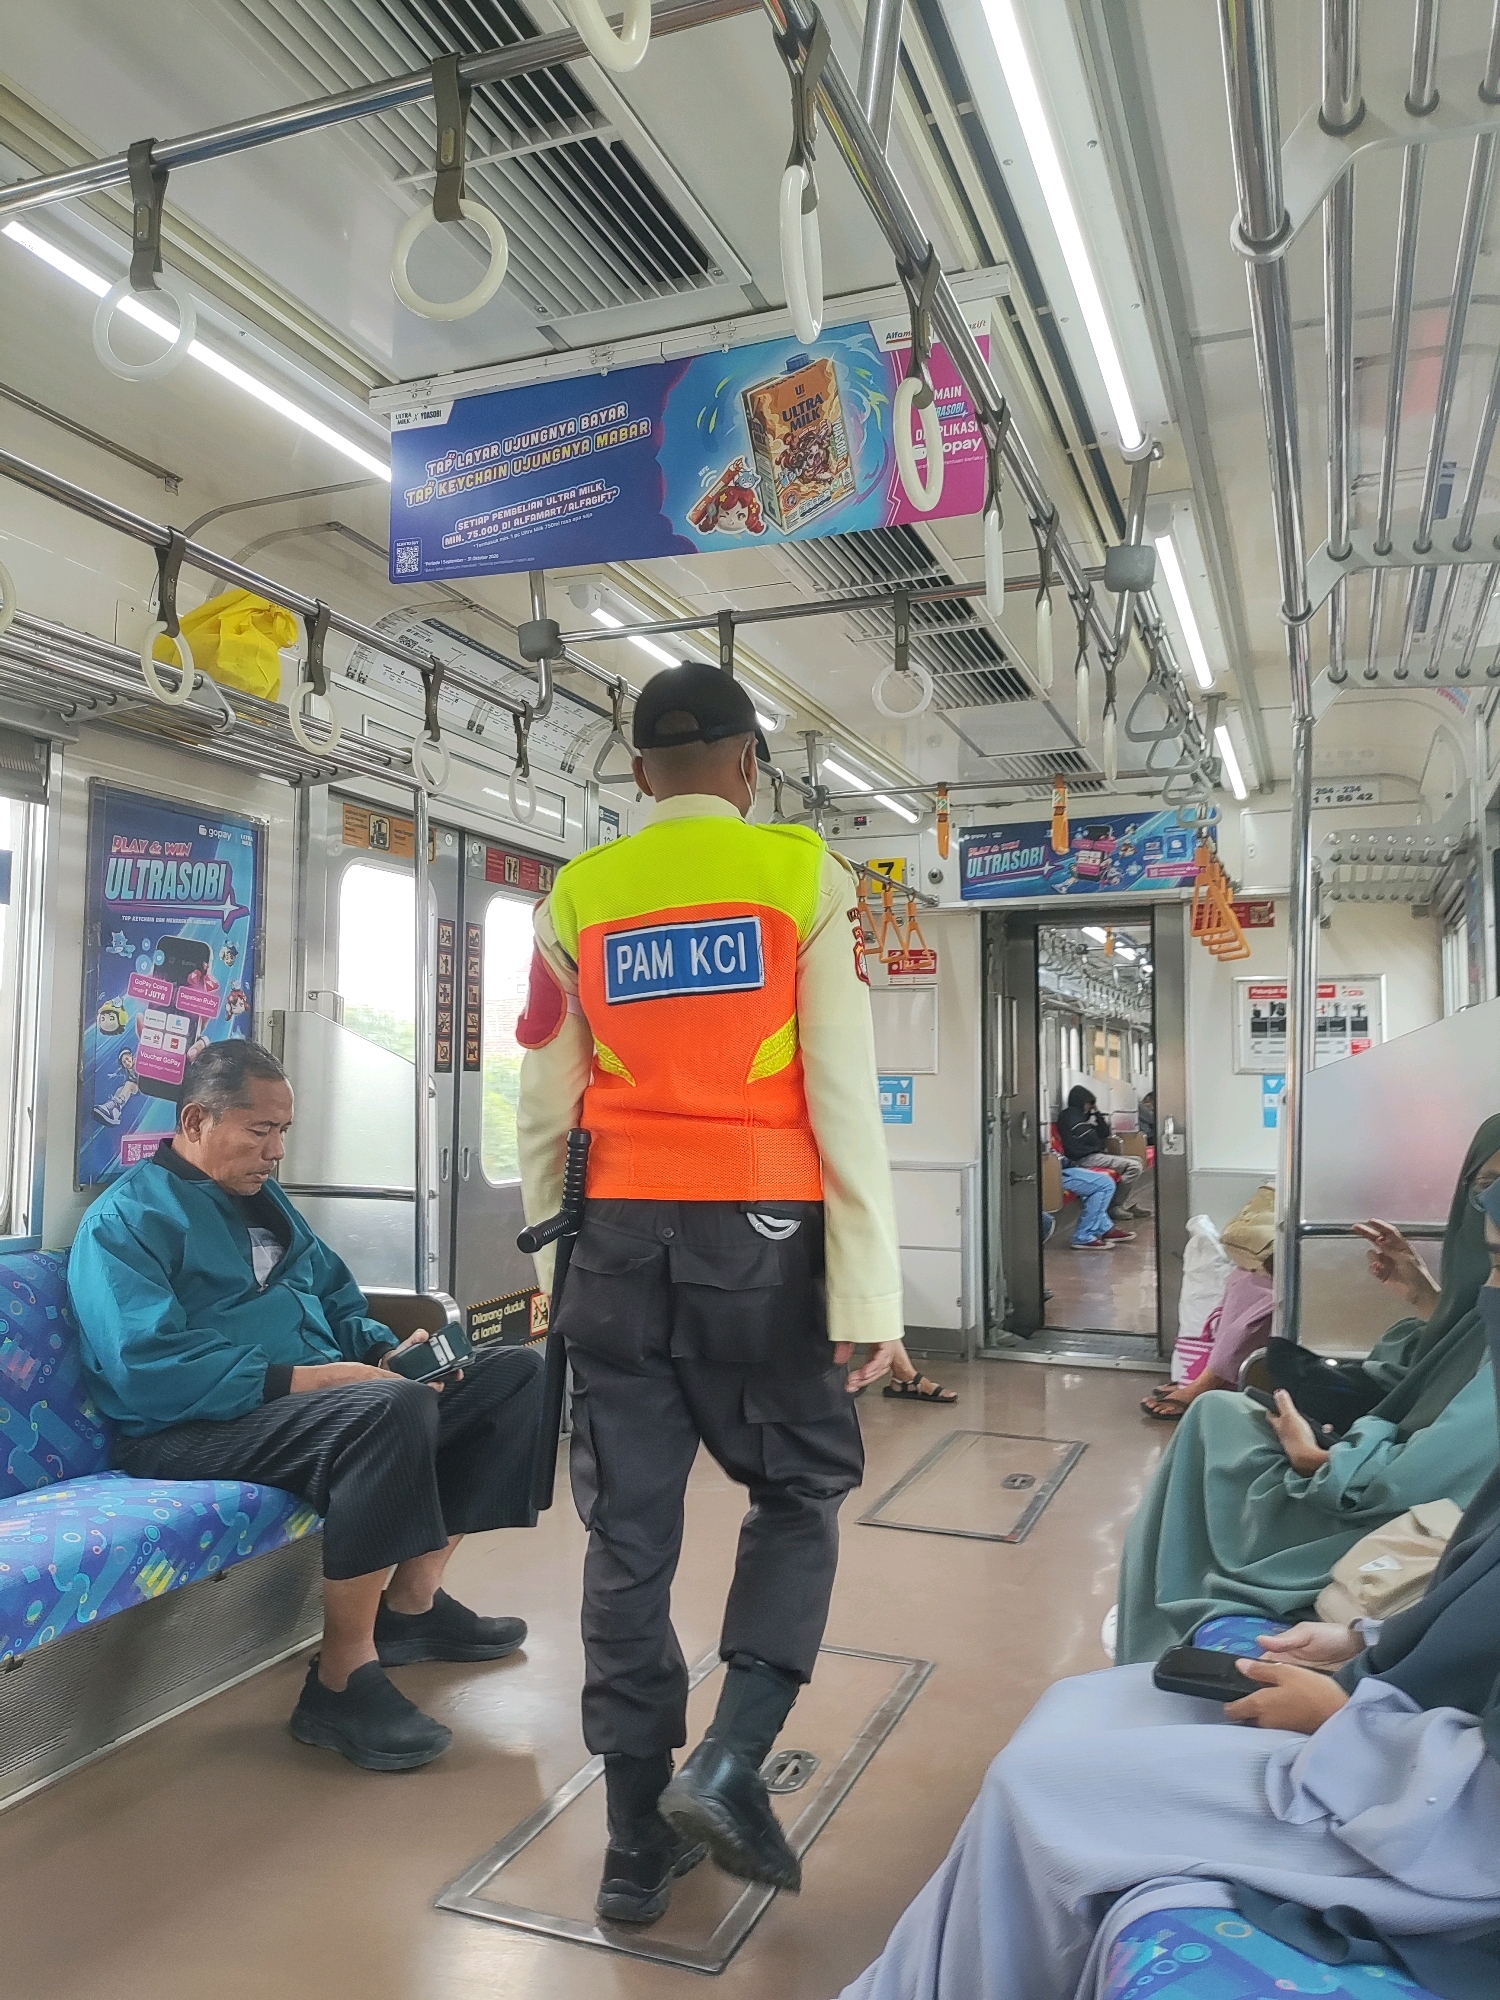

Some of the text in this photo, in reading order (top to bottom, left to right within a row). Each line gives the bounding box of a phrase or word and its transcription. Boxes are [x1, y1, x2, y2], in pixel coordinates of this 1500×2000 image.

[886, 329, 912, 339] Alfam
[934, 385, 962, 400] MAIN
[395, 412, 412, 420] ULTRA
[421, 410, 442, 420] YOASOBI
[782, 394, 824, 422] ULTRA
[936, 401, 966, 418] RASOBI
[790, 406, 820, 432] MILK
[427, 458, 454, 476] TAP
[457, 443, 499, 467] LAYAR
[504, 420, 577, 453] UJUNGNYA
[581, 404, 626, 429] BAYAR
[833, 418, 849, 458] YOASOBI
[916, 421, 979, 441] D PLIKASI
[943, 437, 983, 455] opay
[406, 487, 434, 505] TAP
[438, 463, 509, 496] KEYCHAIN
[513, 438, 590, 473] UJUNGNYA
[596, 420, 648, 448] MABAR
[457, 482, 603, 531] SETIAP PEMBELIAN ULTRA MILK
[445, 533, 464, 546] MIN.
[467, 525, 499, 540] 75.000
[502, 521, 511, 531] DI
[521, 529, 533, 537] Ultra
[1356, 793, 1373, 801] 42
[208, 828, 232, 841] gopay
[111, 835, 192, 856] PLAY & WIN
[967, 847, 1045, 878] ULTRASOBI
[105, 857, 227, 900] ULTRASOBI
[616, 931, 747, 985] PAM KCI
[134, 979, 168, 992] GoPay Coins
[148, 989, 166, 1000] JUTA
[203, 997, 218, 1007] Ruby
[140, 1050, 181, 1067] Voucher GoPay
[472, 1299, 526, 1326] Dilarang duduk
[472, 1322, 502, 1341] di lantai
